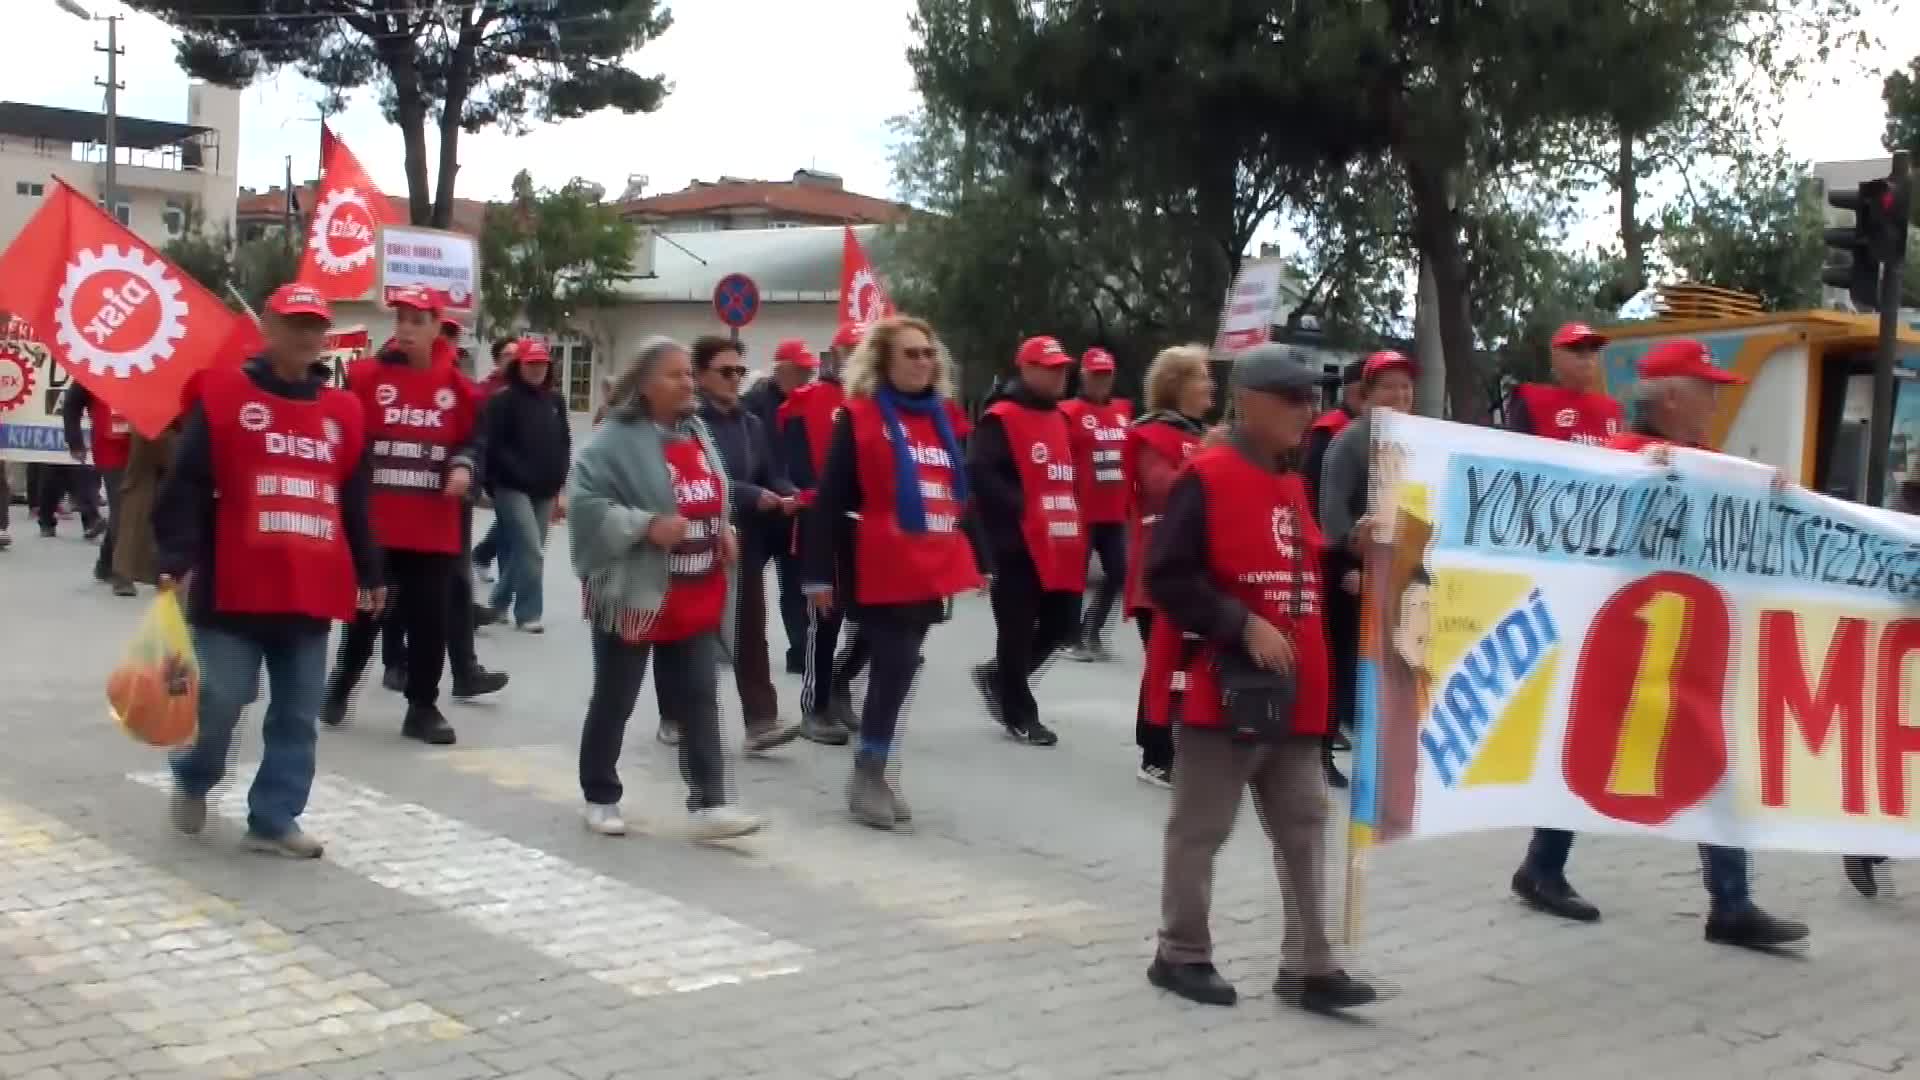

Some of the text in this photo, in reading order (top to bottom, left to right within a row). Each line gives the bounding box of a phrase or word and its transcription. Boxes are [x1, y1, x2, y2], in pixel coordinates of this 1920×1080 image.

[265, 429, 336, 463] DİSK
[384, 403, 442, 428] DİSK
[1420, 587, 1562, 788] HAYDİ
[1605, 590, 1690, 797] 1
